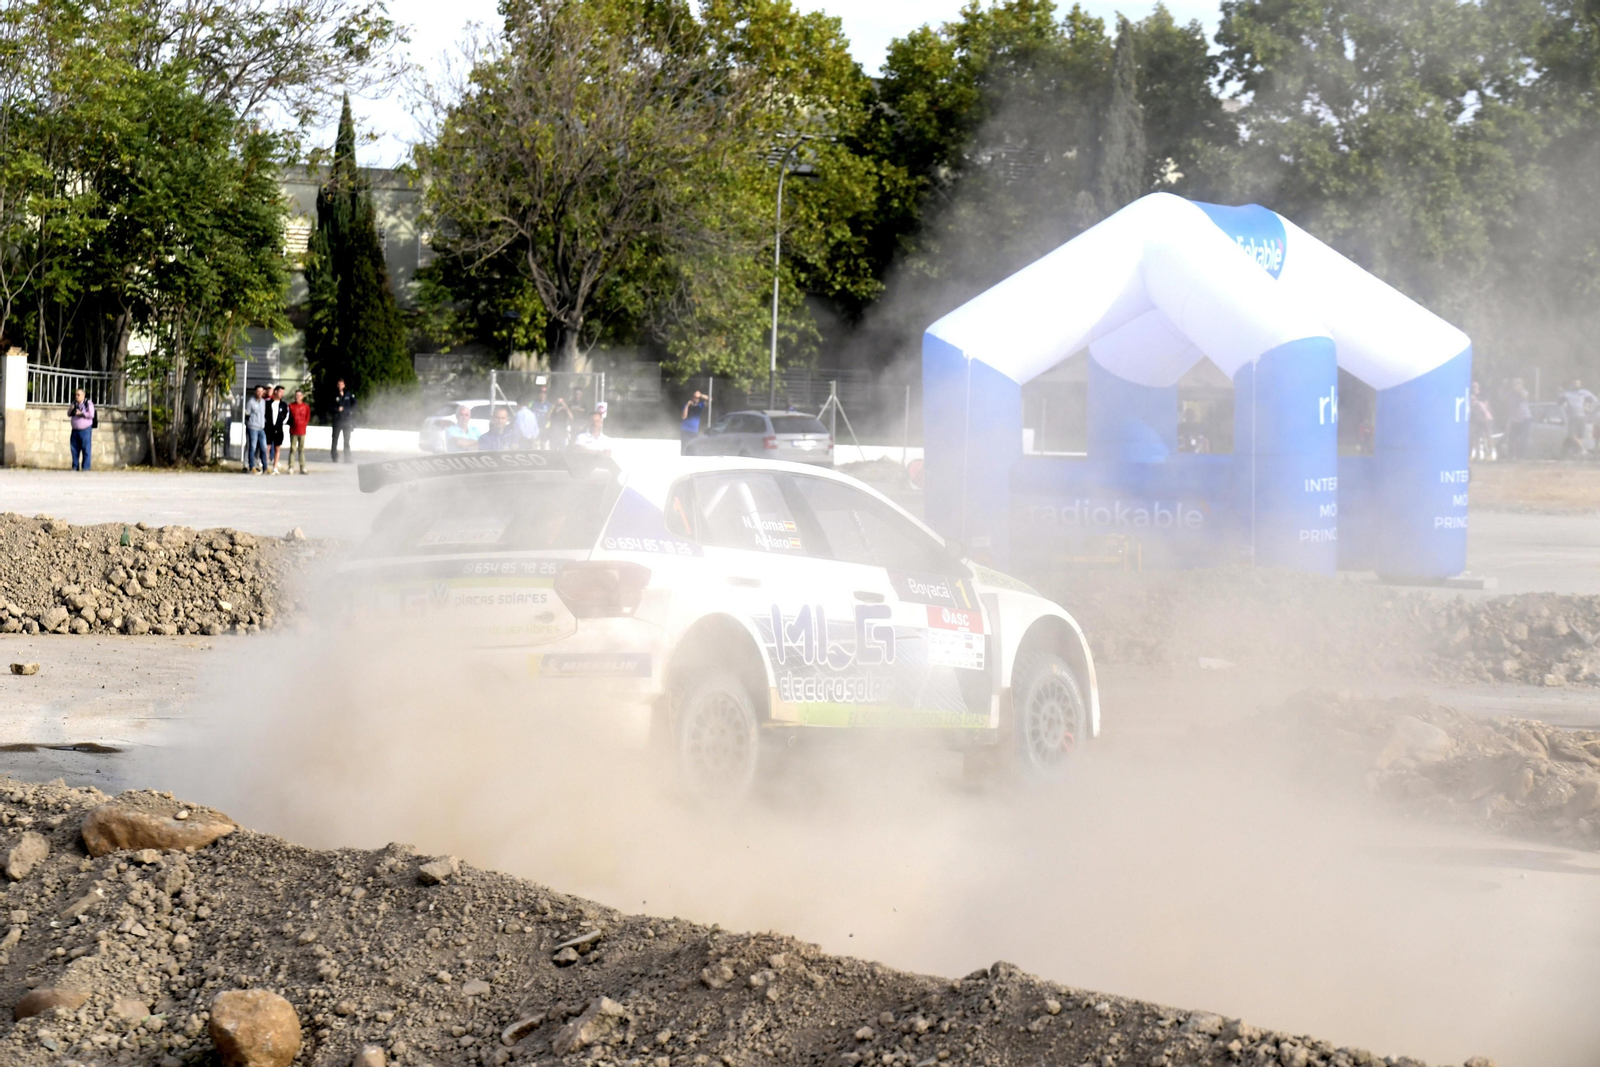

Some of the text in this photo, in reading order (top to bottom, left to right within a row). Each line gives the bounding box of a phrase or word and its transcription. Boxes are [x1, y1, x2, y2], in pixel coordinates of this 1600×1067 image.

[382, 453, 548, 476] SAMSUNG SSD
[742, 515, 785, 531] N.oma
[1028, 499, 1205, 529] radiokable
[617, 537, 692, 555] 654 85 78 26
[474, 562, 557, 573] 654 85 78 26
[906, 578, 972, 609] Boyacá 1
[950, 612, 970, 626] ASC
[770, 603, 896, 672] MLG
[561, 660, 638, 671] MICHELIN
[780, 670, 895, 703] electrosolar
